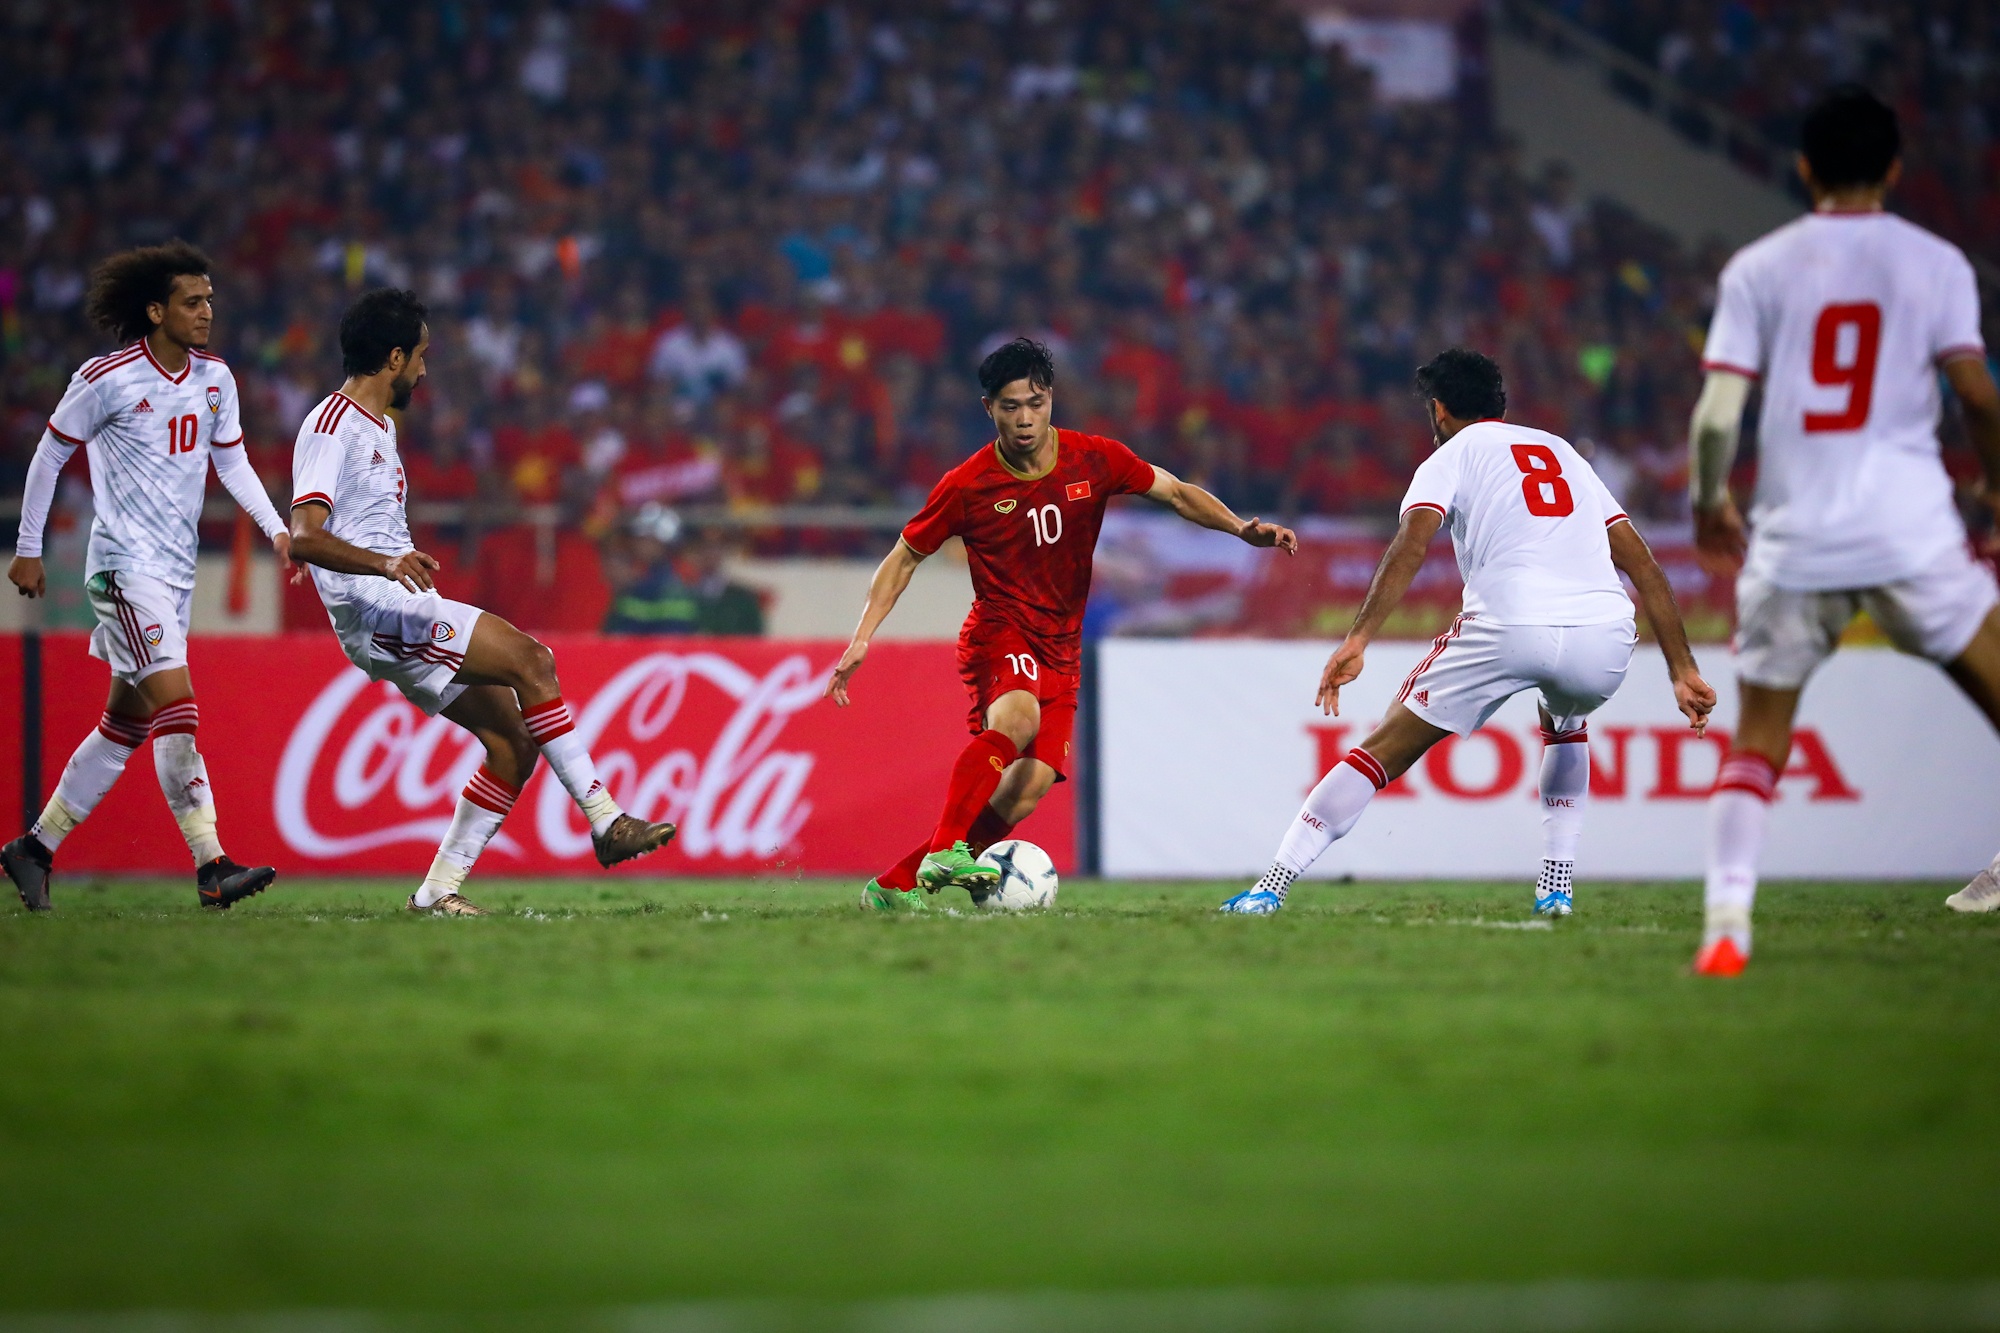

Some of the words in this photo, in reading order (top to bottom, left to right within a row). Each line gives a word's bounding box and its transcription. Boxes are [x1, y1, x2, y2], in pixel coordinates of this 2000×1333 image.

[1803, 302, 1882, 434] 9
[168, 413, 198, 456] 10
[1510, 444, 1574, 517] 8
[1026, 503, 1063, 547] 10
[1004, 653, 1038, 682] 10
[1301, 810, 1328, 832] UAE
[1545, 797, 1575, 808] UAE
